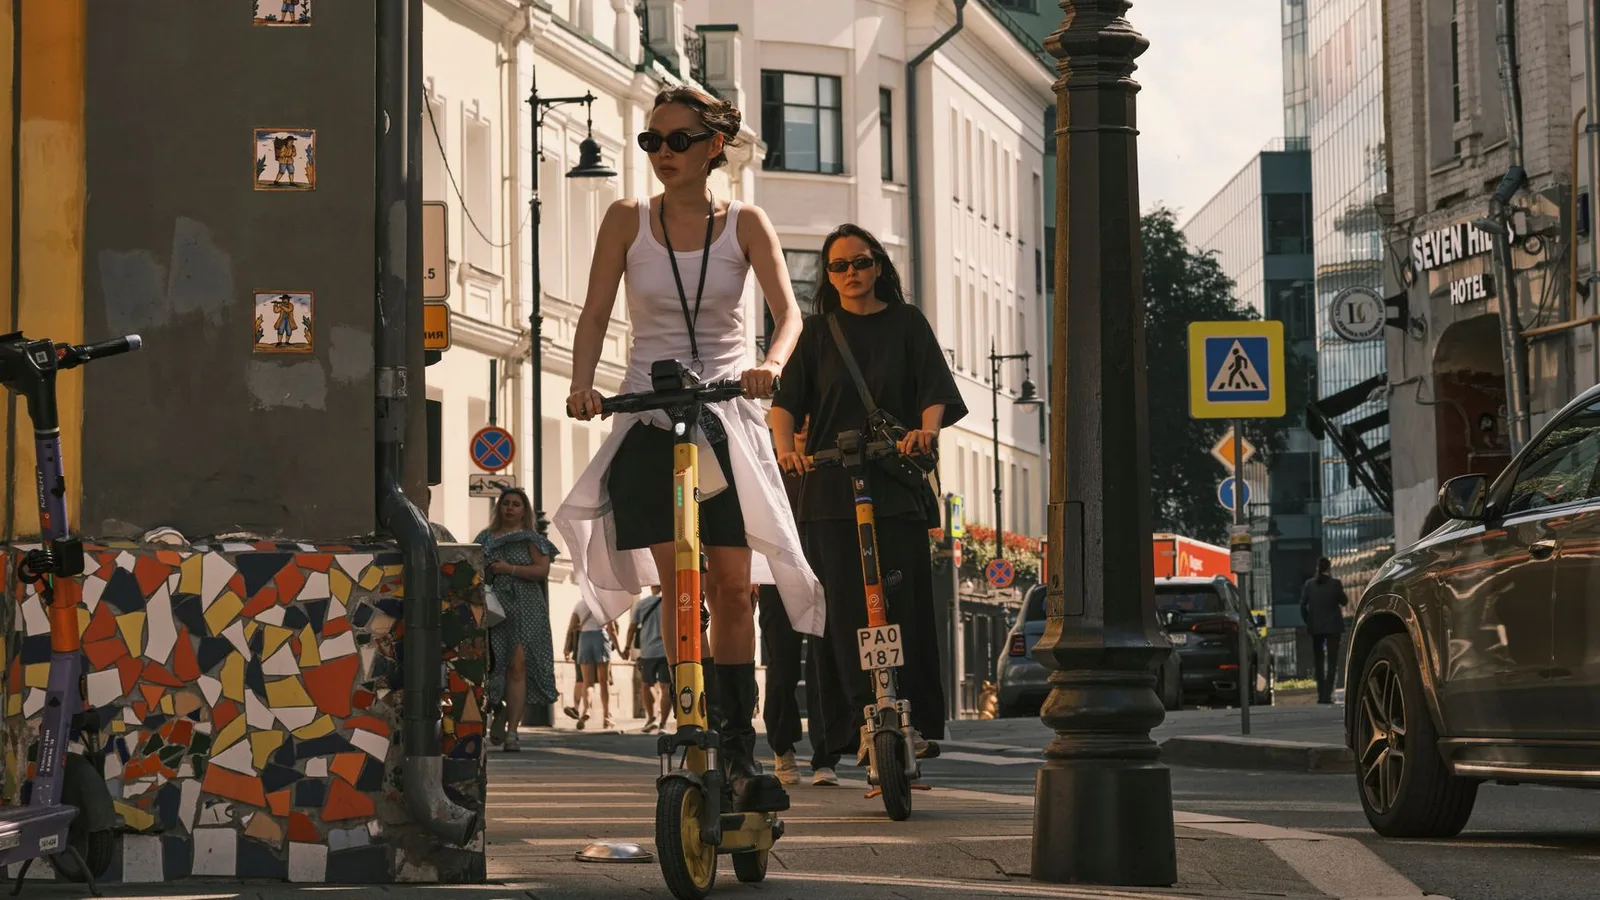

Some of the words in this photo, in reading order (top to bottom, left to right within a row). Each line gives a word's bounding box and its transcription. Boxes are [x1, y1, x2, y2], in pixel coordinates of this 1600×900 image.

[1412, 224, 1463, 272] SEVEN
[1467, 220, 1515, 256] HIL
[1450, 273, 1487, 305] HOTEL
[864, 648, 900, 667] 187
